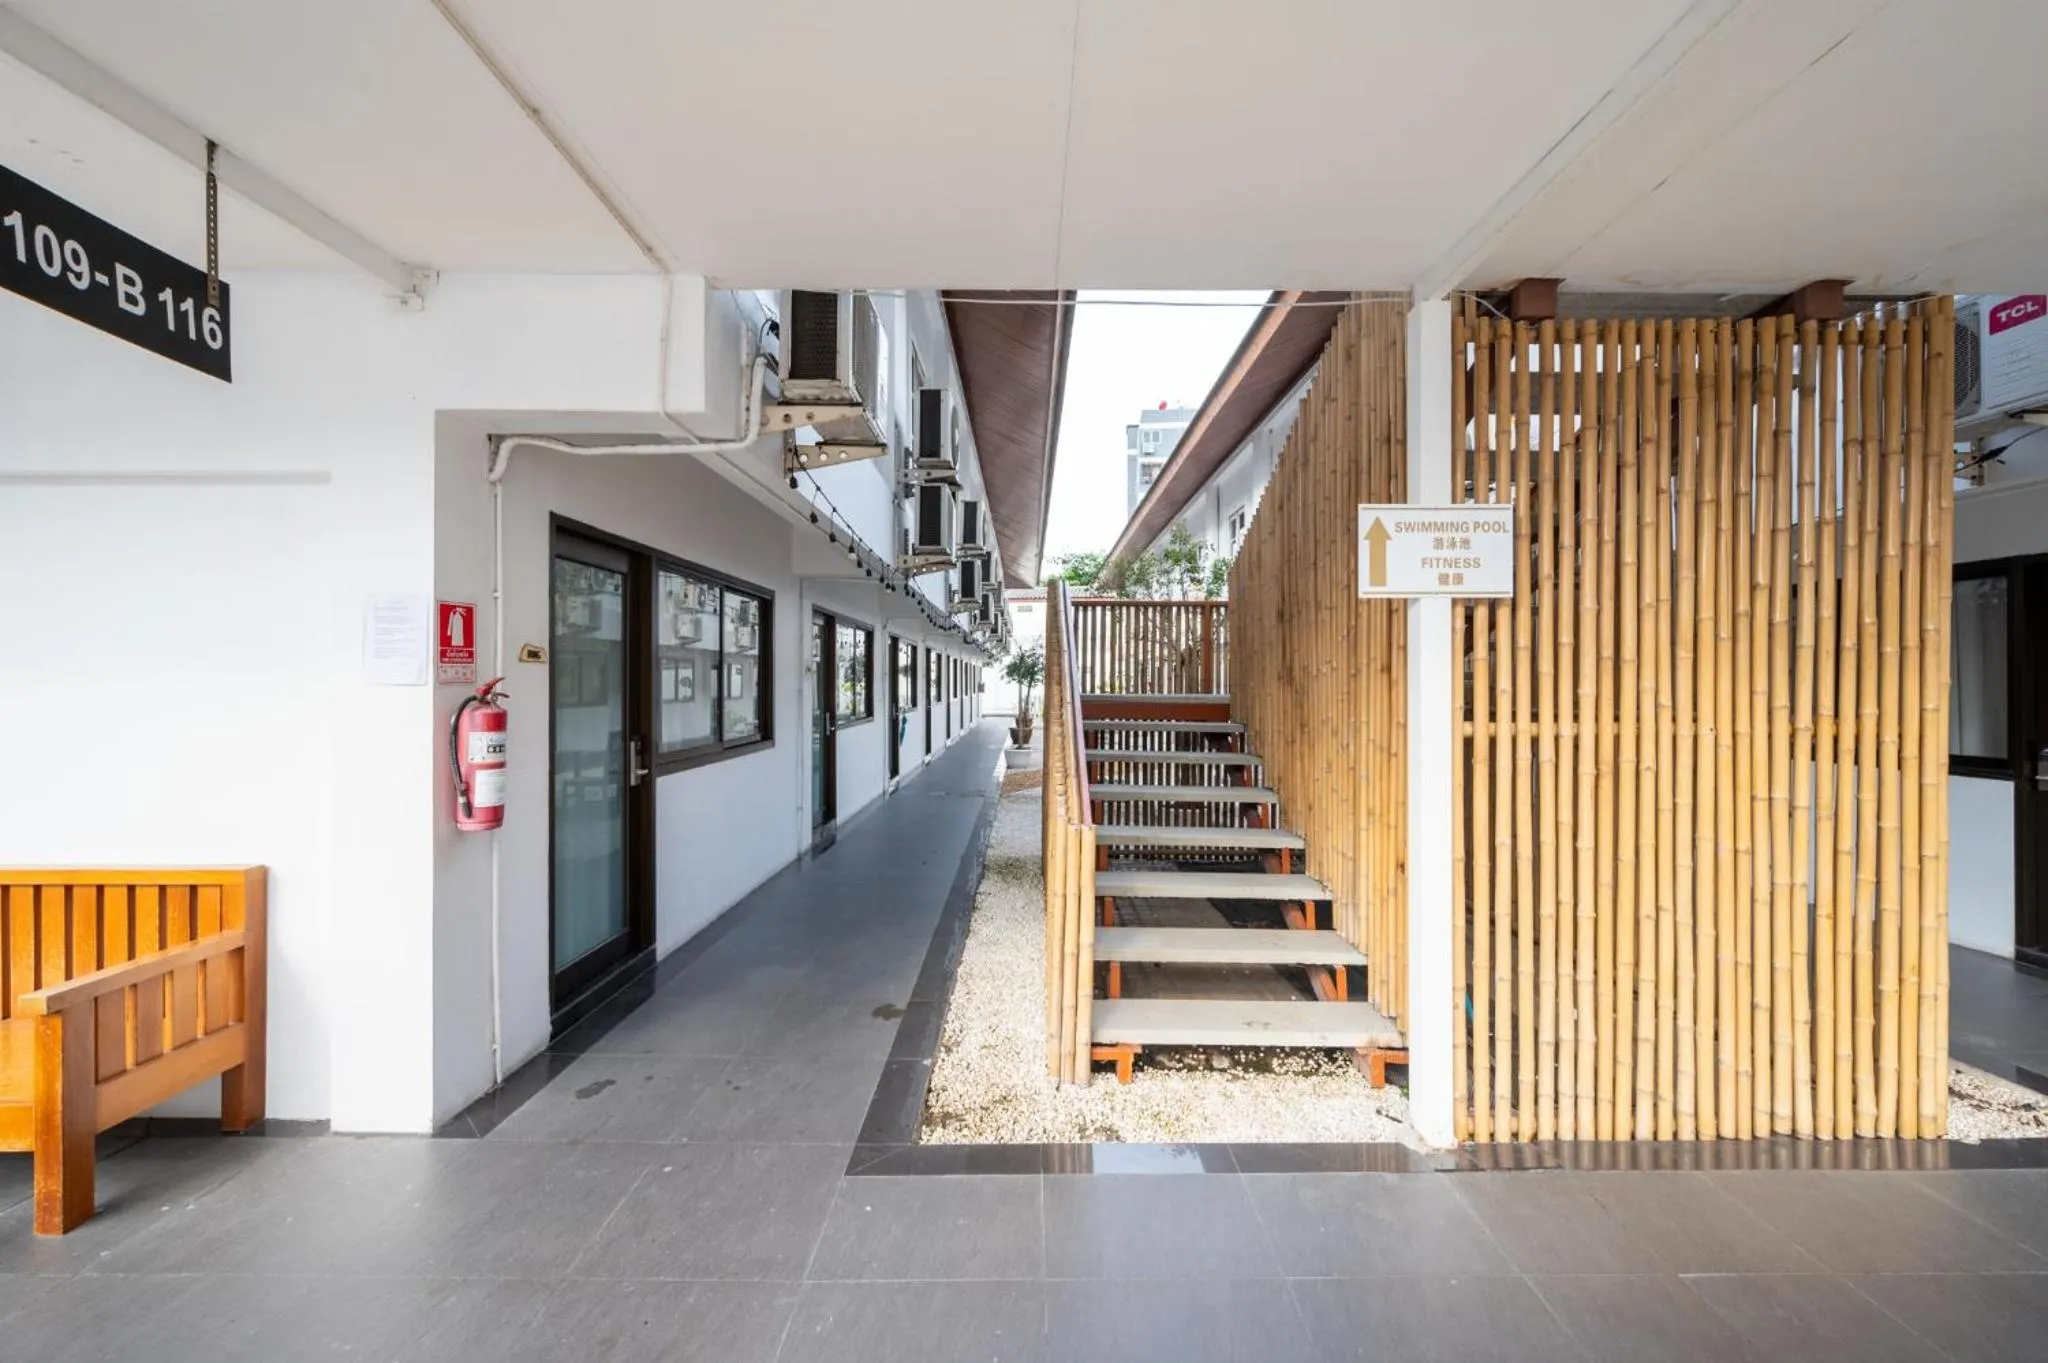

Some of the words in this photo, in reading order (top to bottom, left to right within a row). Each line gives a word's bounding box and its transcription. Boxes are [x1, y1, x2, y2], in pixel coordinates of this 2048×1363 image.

[3, 210, 146, 316] 109-B
[157, 287, 223, 350] 116
[1996, 301, 2039, 322] TCL
[1394, 521, 1470, 533] SWIMMING
[1473, 521, 1509, 533] POOL
[1421, 557, 1482, 569] FITNESS
